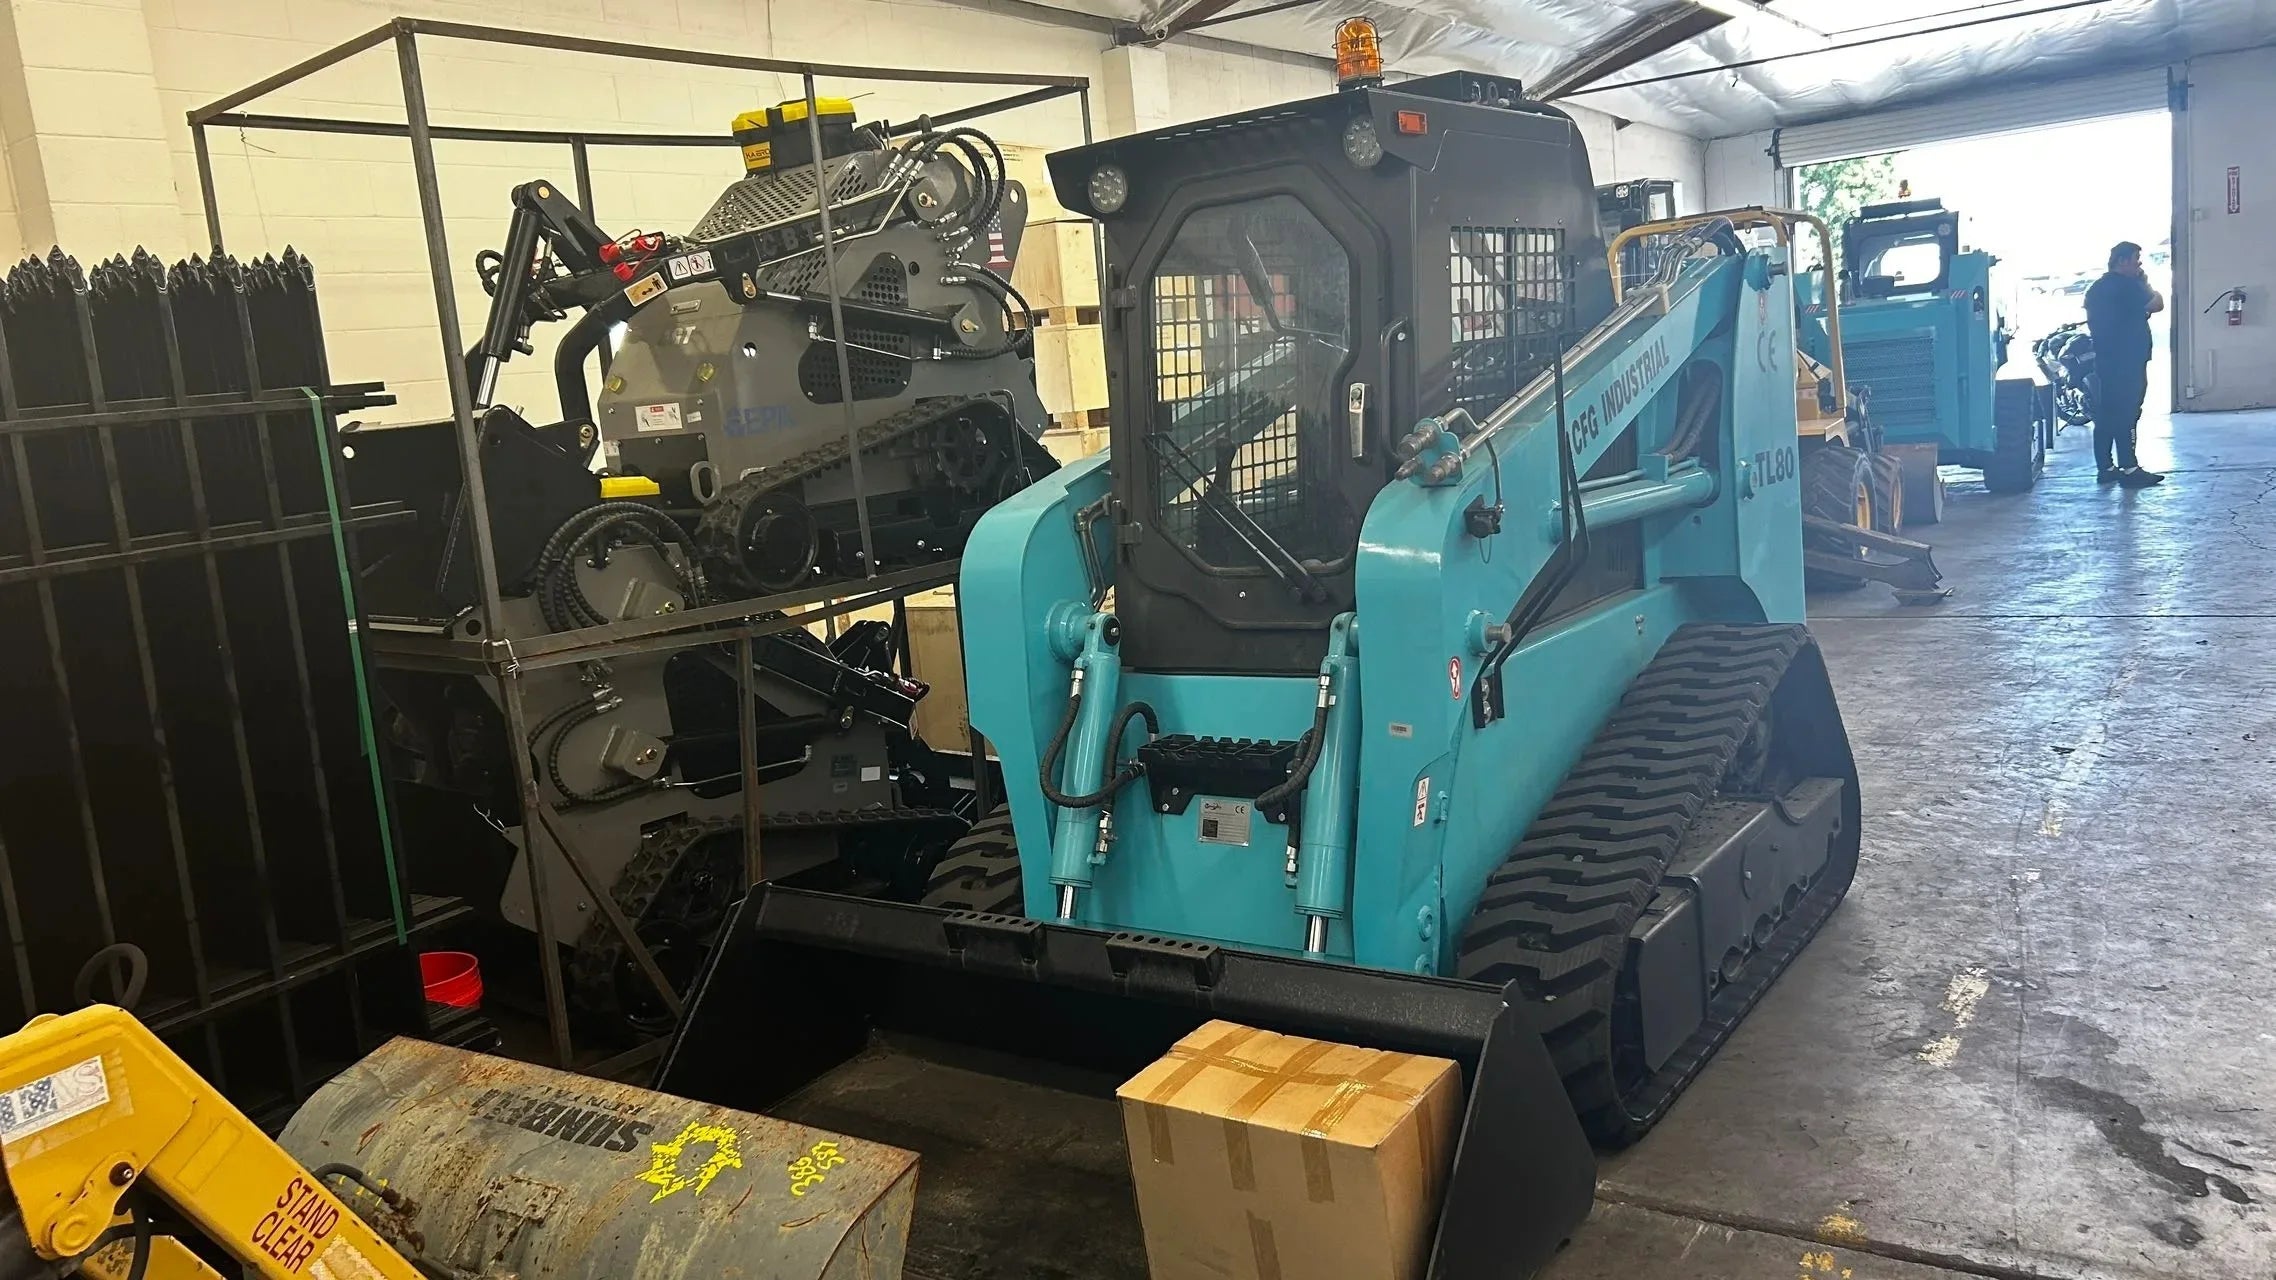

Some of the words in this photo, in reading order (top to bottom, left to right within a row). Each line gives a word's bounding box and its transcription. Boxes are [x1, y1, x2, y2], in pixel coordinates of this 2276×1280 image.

[1571, 404, 1599, 455] CFG
[1601, 336, 1670, 426] INDUSTRIAL
[276, 1177, 340, 1240] STAND
[251, 1211, 315, 1275] CLEAR
